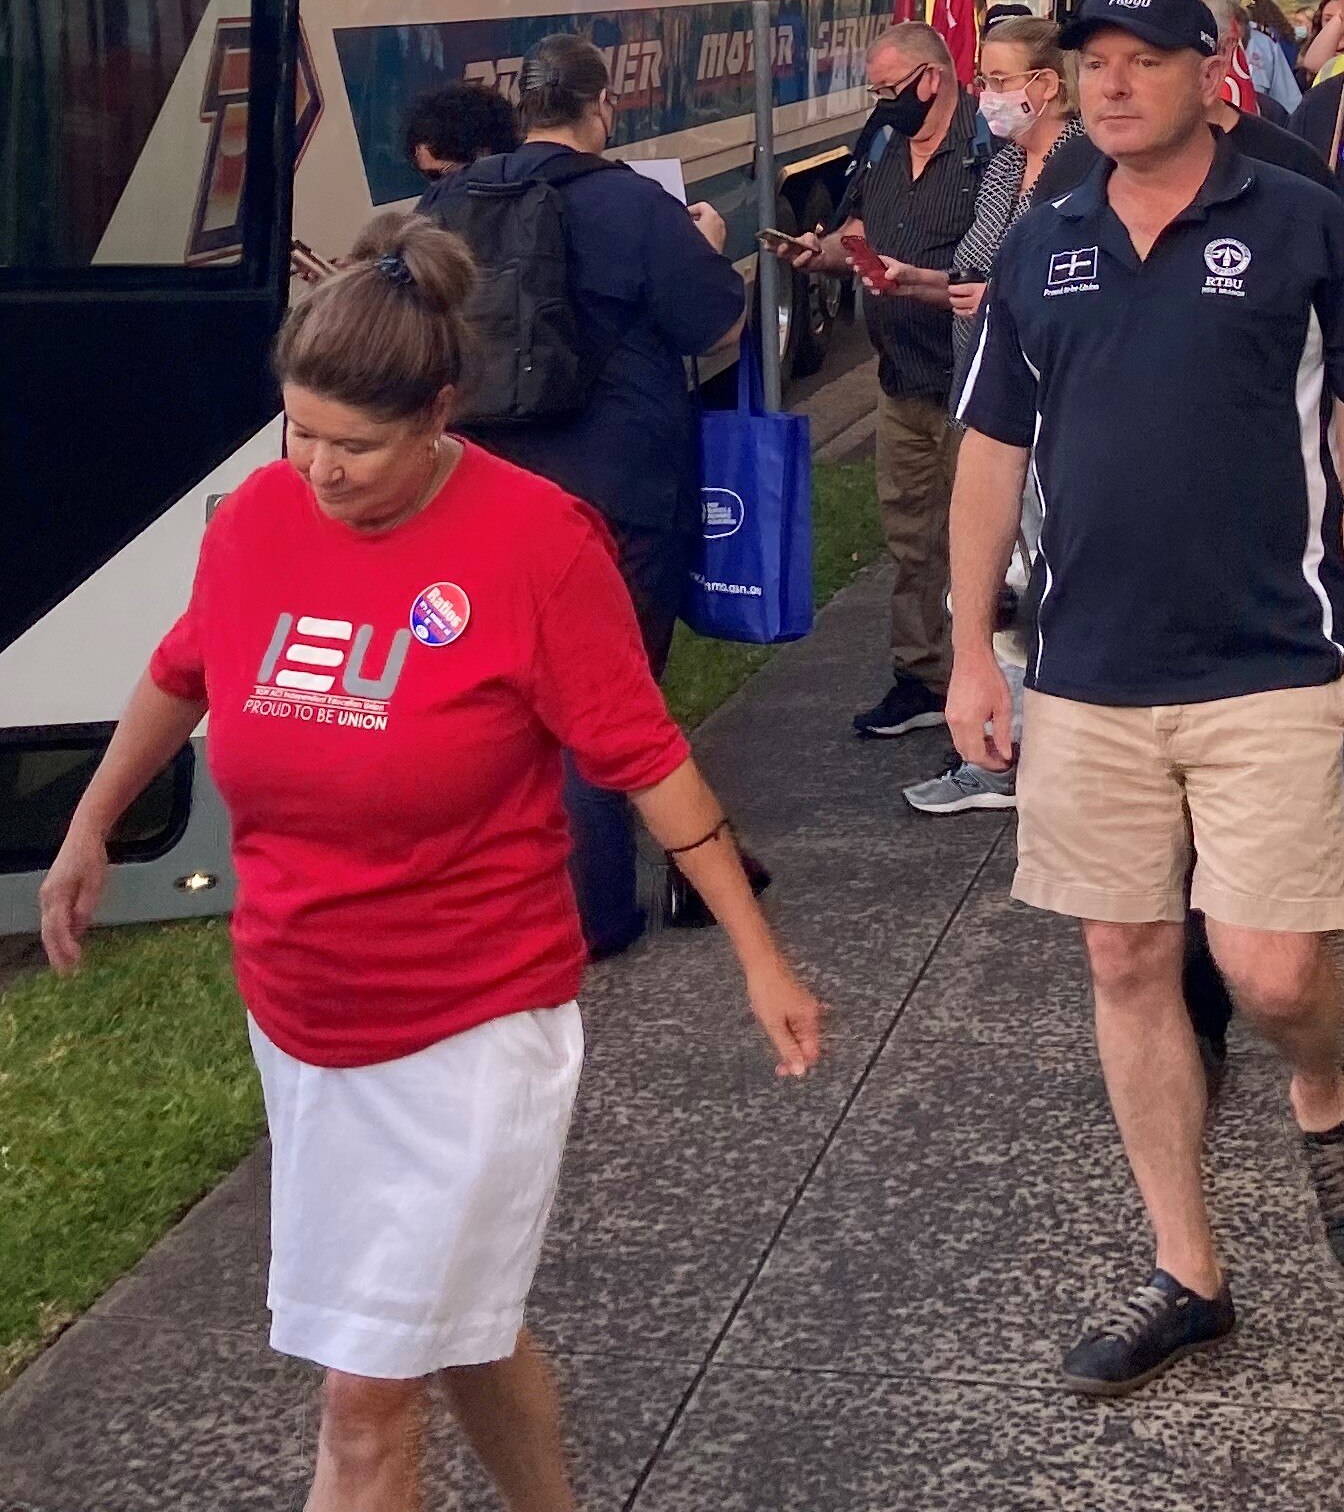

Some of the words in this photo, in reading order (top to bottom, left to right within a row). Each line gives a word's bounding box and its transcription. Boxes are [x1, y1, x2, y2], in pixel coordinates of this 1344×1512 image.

[1205, 275, 1244, 290] RTBU
[426, 586, 463, 628] Ratios
[258, 611, 412, 700] IEU
[243, 699, 292, 718] PROUD
[294, 704, 314, 721] TO
[316, 708, 336, 724] BE
[337, 712, 389, 731] UNION
